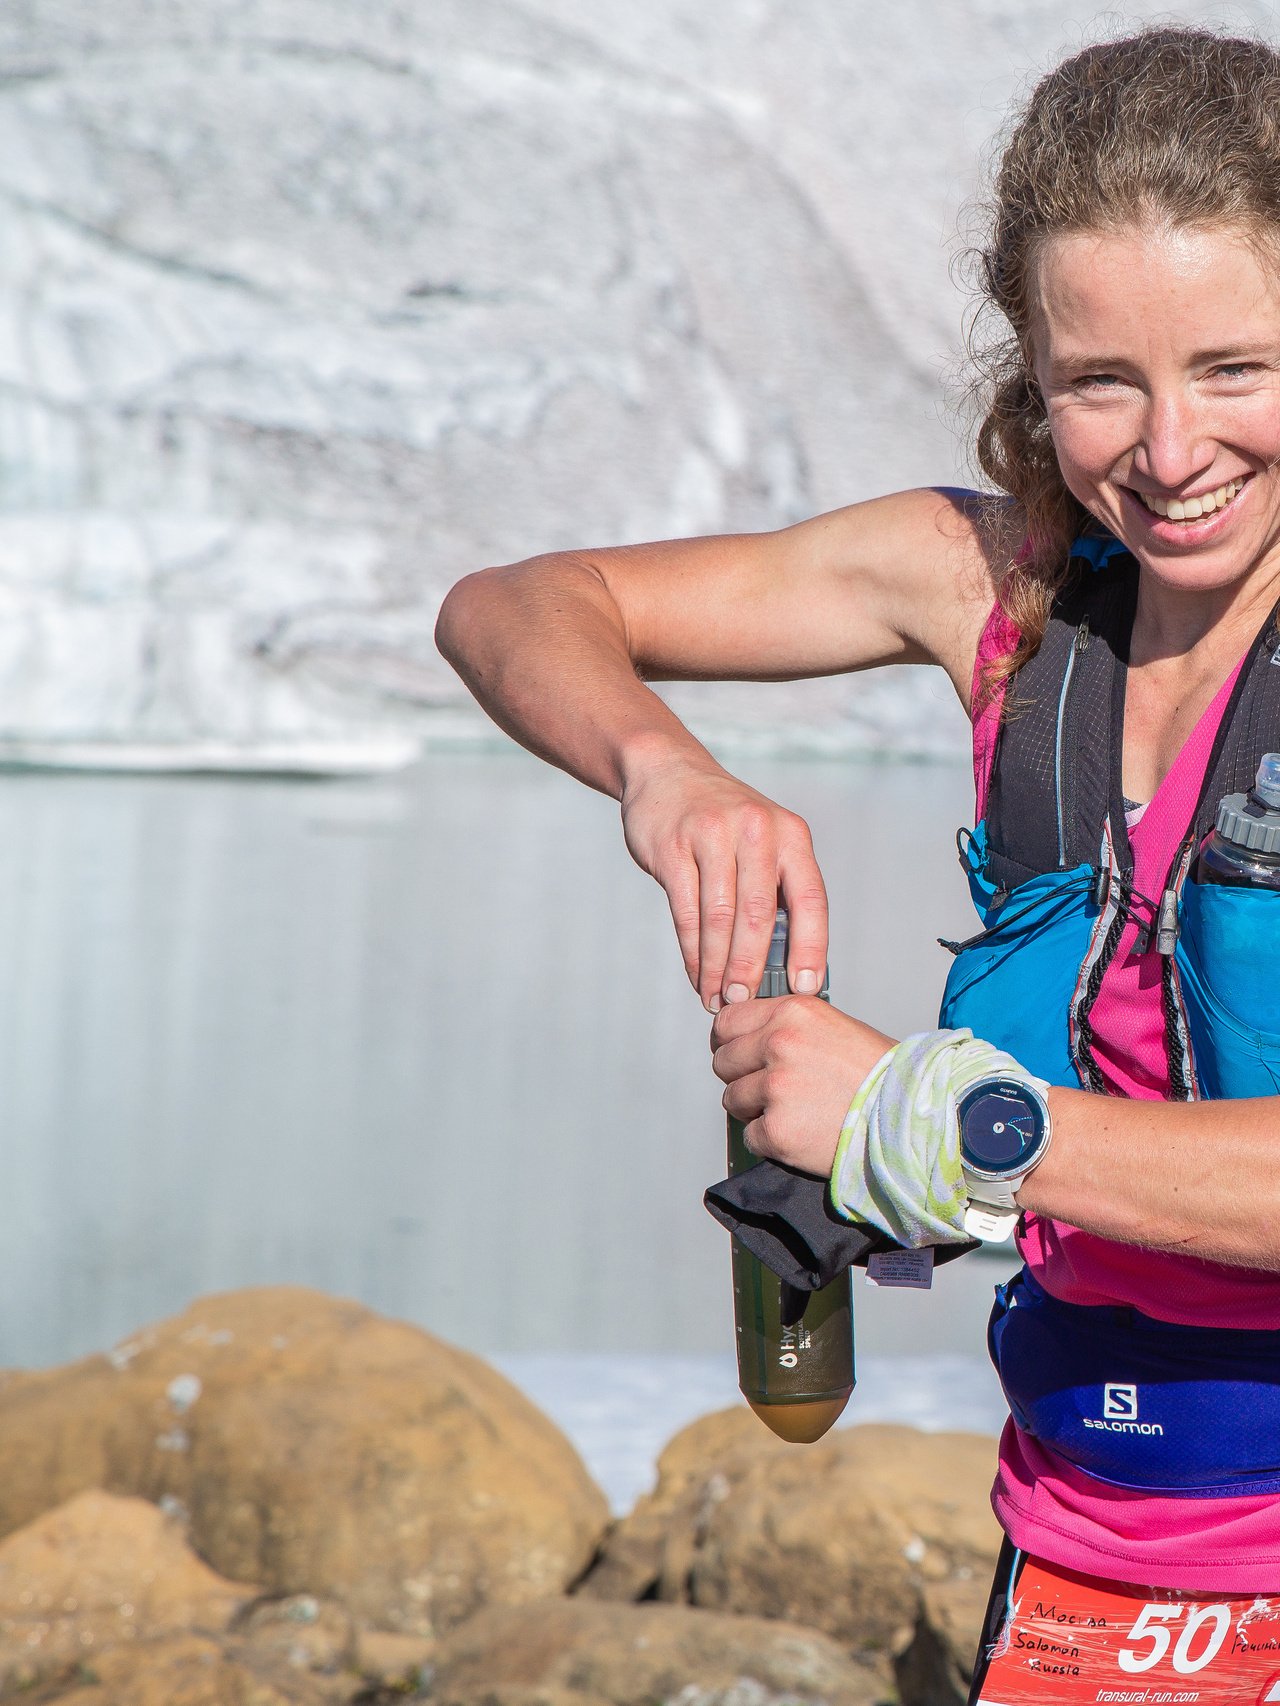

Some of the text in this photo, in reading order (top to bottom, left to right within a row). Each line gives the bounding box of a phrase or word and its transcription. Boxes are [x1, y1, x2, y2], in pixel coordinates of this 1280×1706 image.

[1013, 1632, 1079, 1657] Salomon
[1118, 1603, 1231, 1674] 50
[1096, 1688, 1199, 1702] transural-run.com
